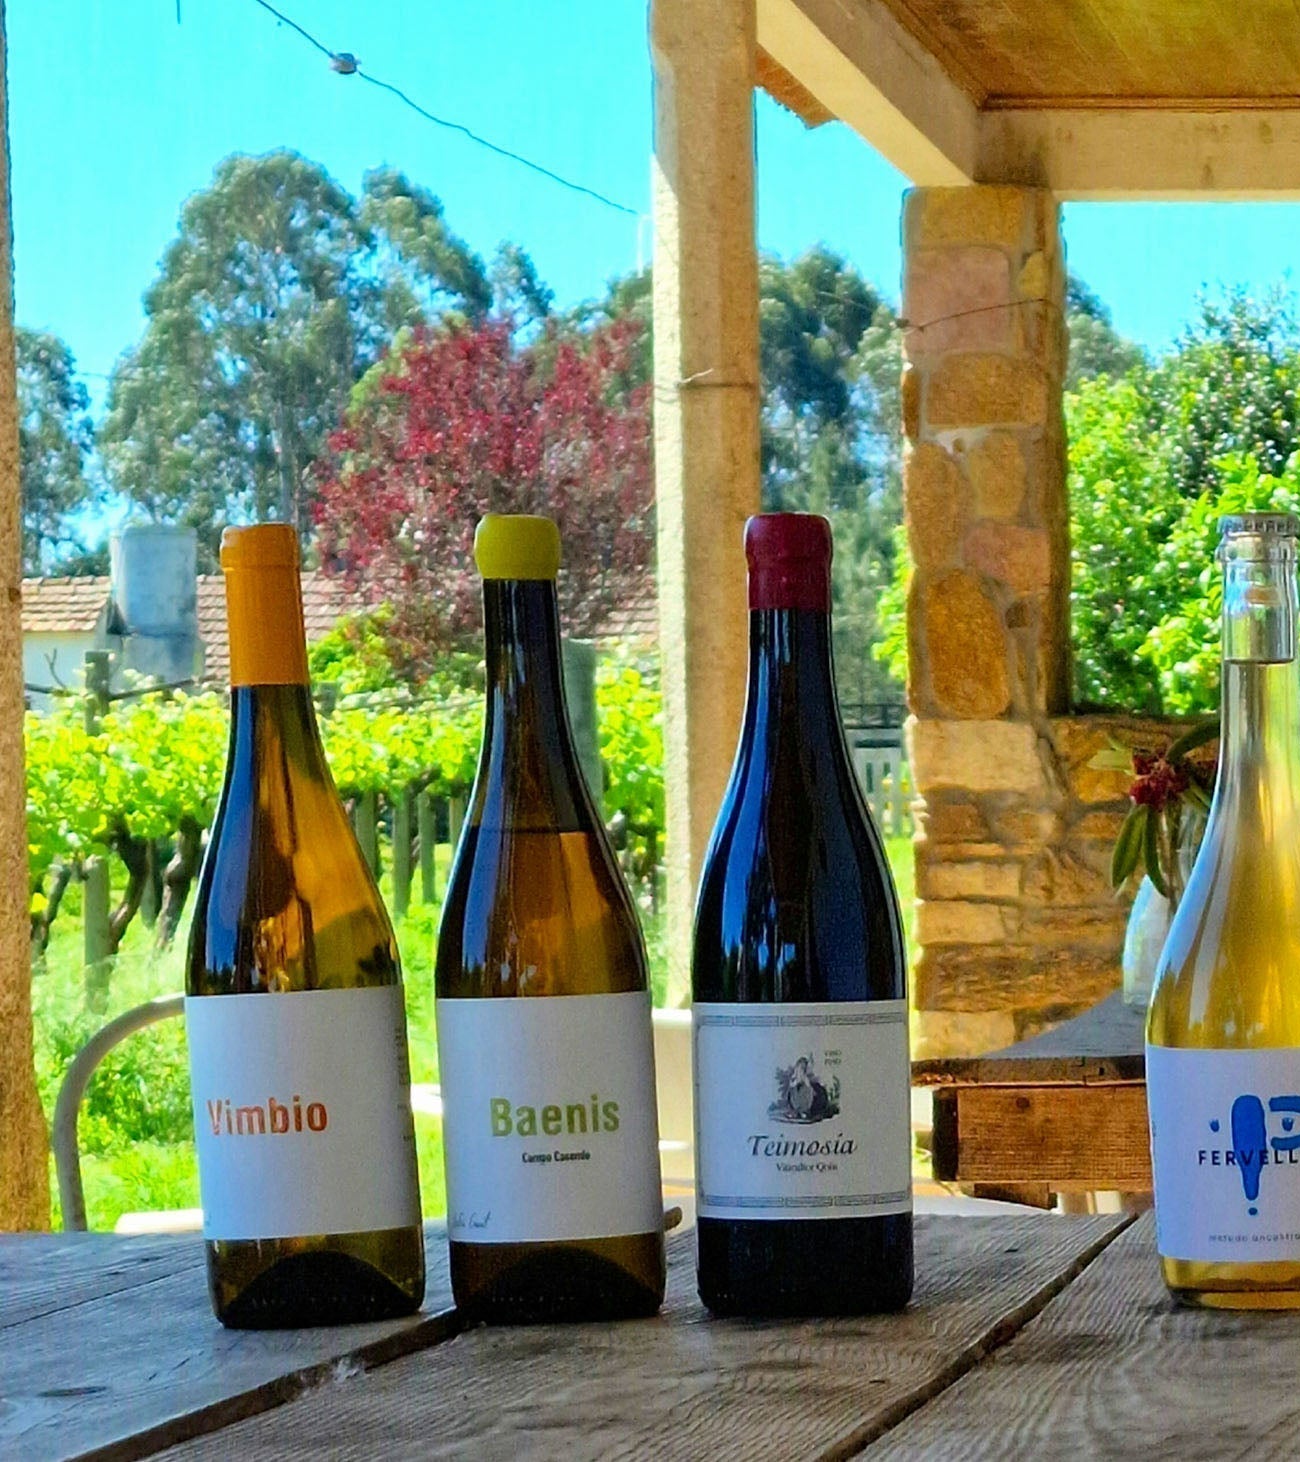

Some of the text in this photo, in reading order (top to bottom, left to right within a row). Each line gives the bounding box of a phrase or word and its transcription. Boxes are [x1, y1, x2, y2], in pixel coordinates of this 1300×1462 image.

[207, 1095, 327, 1135] Vimbio
[490, 1094, 620, 1137] Baenis
[747, 1133, 858, 1156] Teimosía
